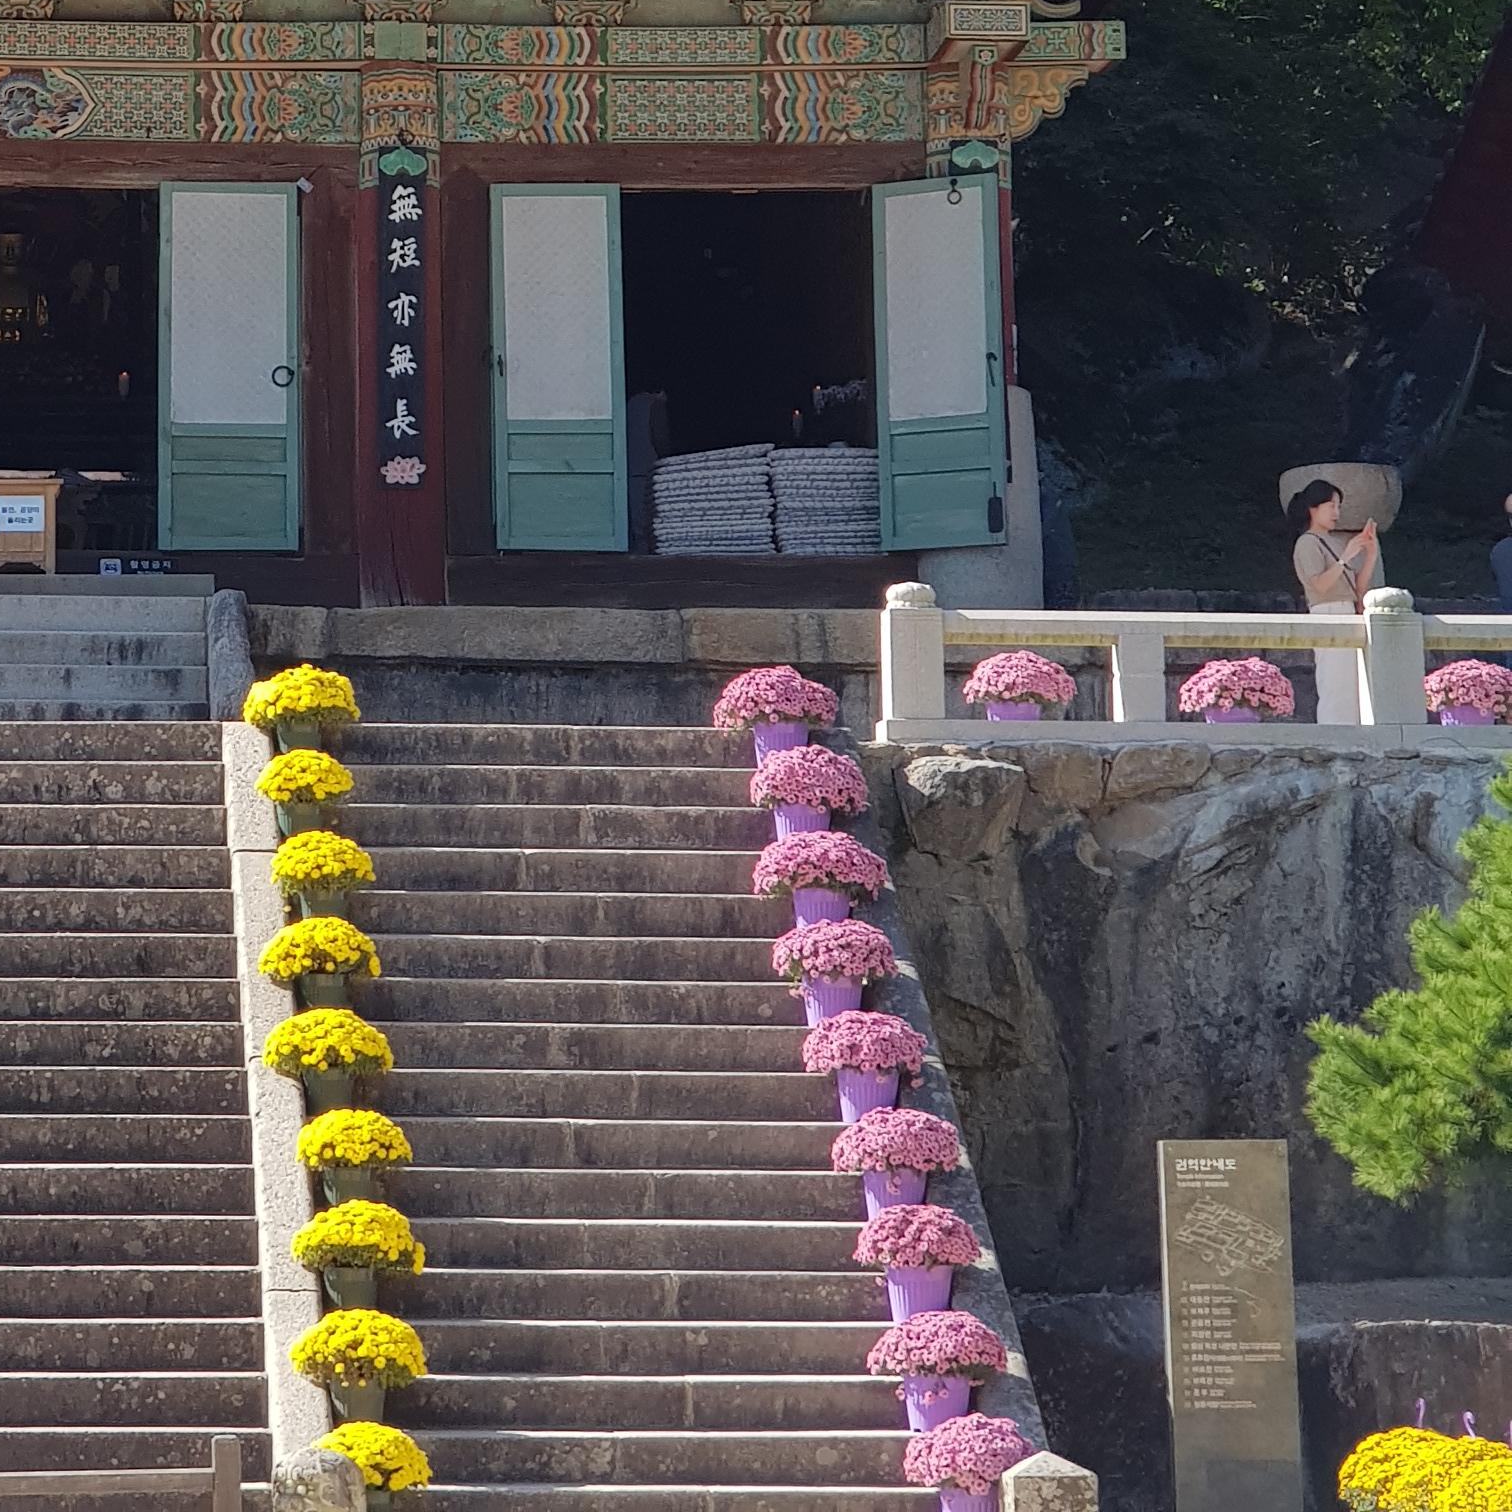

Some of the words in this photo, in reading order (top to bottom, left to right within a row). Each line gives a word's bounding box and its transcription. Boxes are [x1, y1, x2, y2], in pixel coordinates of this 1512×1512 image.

[385, 184, 423, 439] 無短亦無長
[1175, 1157, 1237, 1172] 권역안내도
